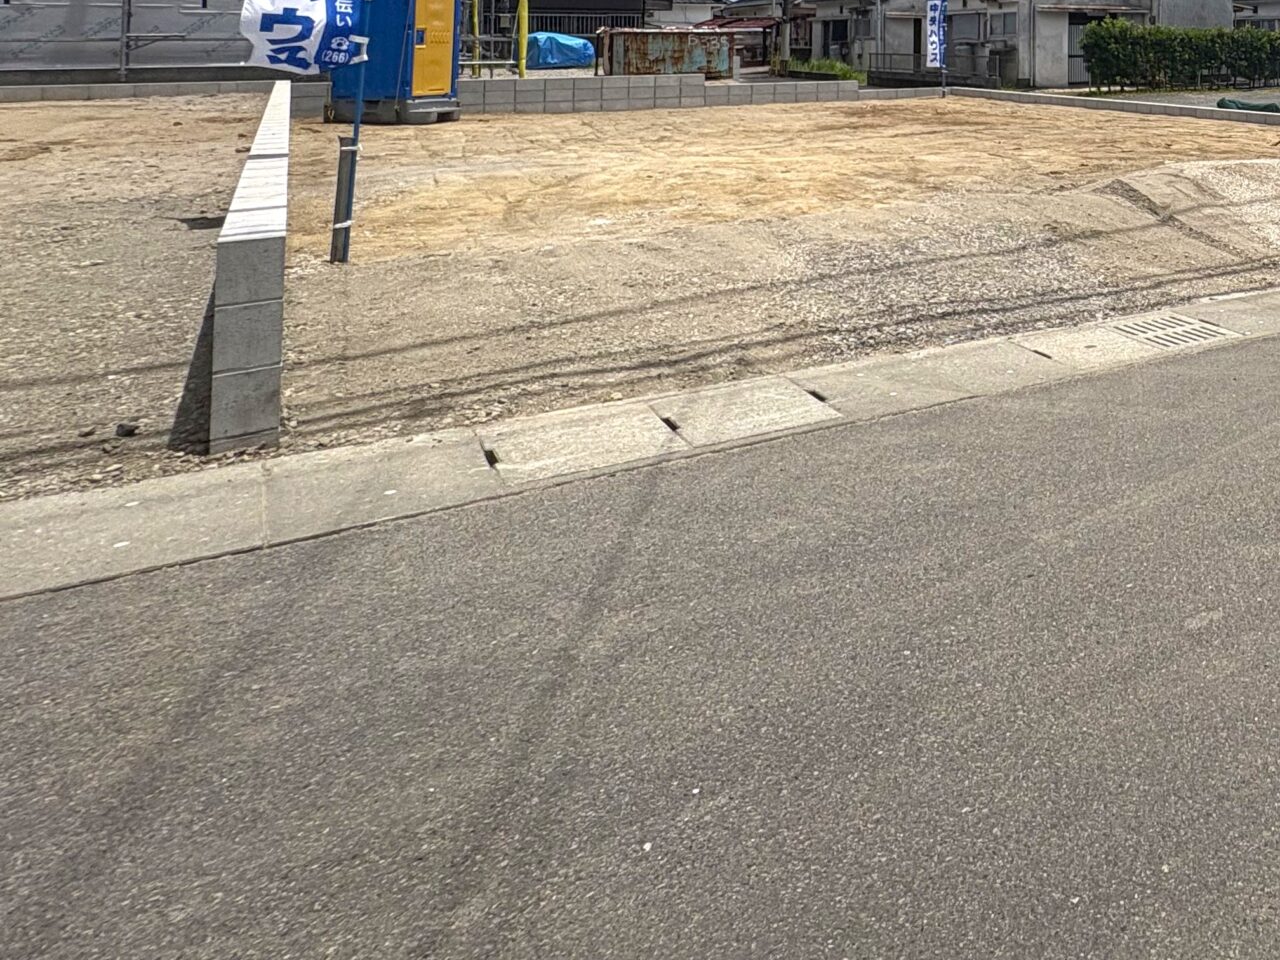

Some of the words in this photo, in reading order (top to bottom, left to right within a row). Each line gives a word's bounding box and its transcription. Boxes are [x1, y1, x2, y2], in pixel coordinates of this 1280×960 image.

[928, 2, 939, 63] 中央ハウス
